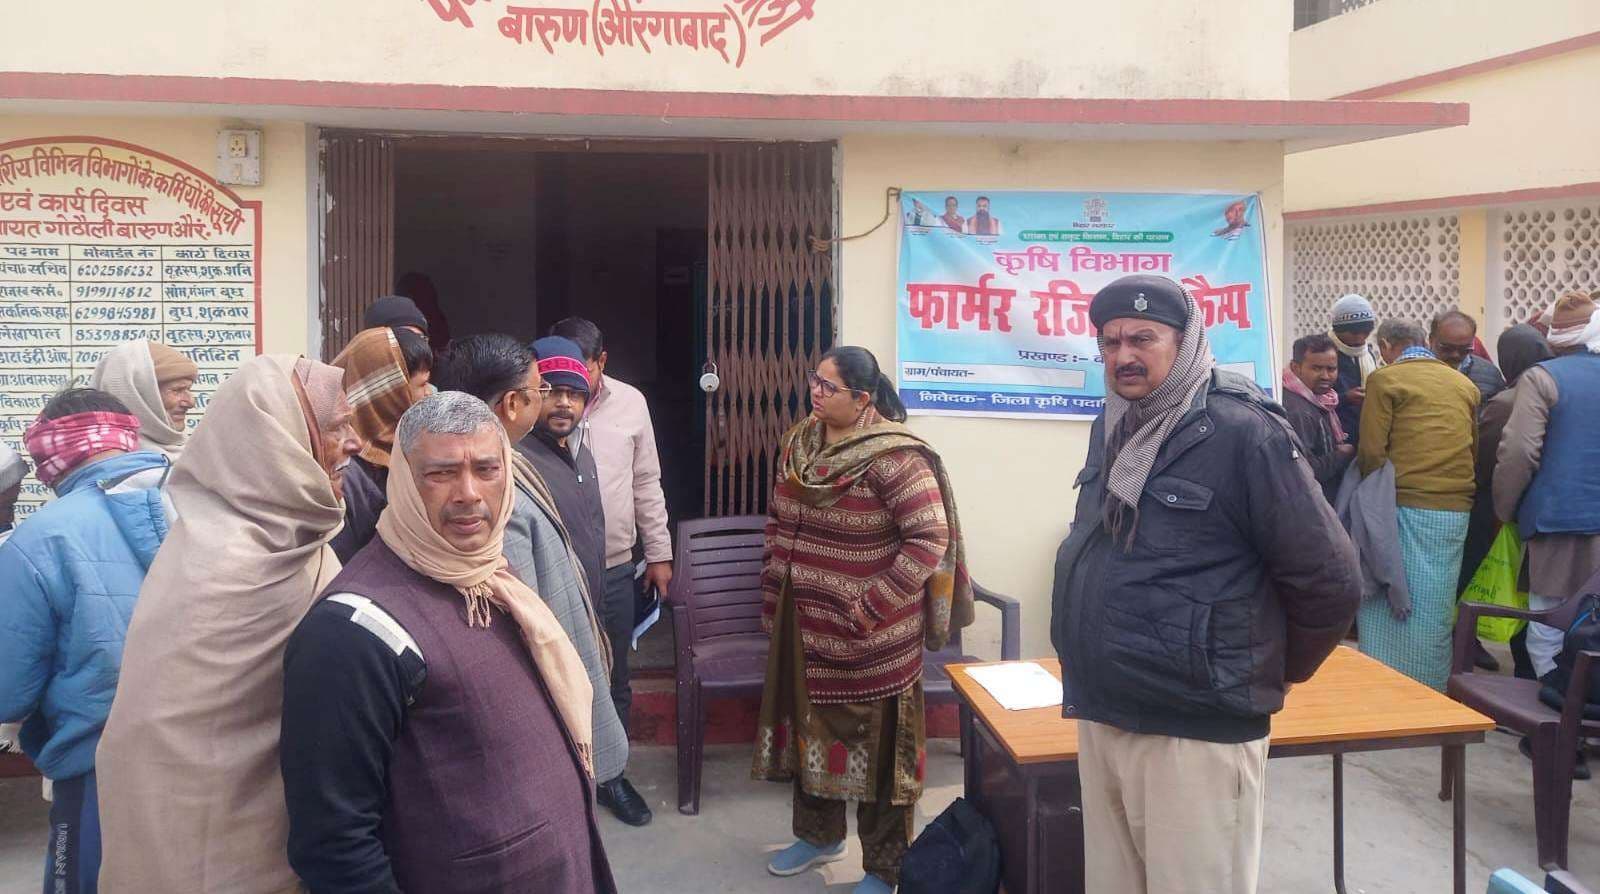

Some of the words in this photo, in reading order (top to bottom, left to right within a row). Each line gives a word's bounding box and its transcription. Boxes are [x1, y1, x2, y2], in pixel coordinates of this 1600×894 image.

[0, 154, 32, 185] रीय
[0, 220, 41, 238] ायत
[993, 246, 1061, 275] कृषि
[1068, 246, 1172, 273] विभाग
[906, 273, 1016, 333] फार्मर
[1030, 279, 1097, 337] रजि
